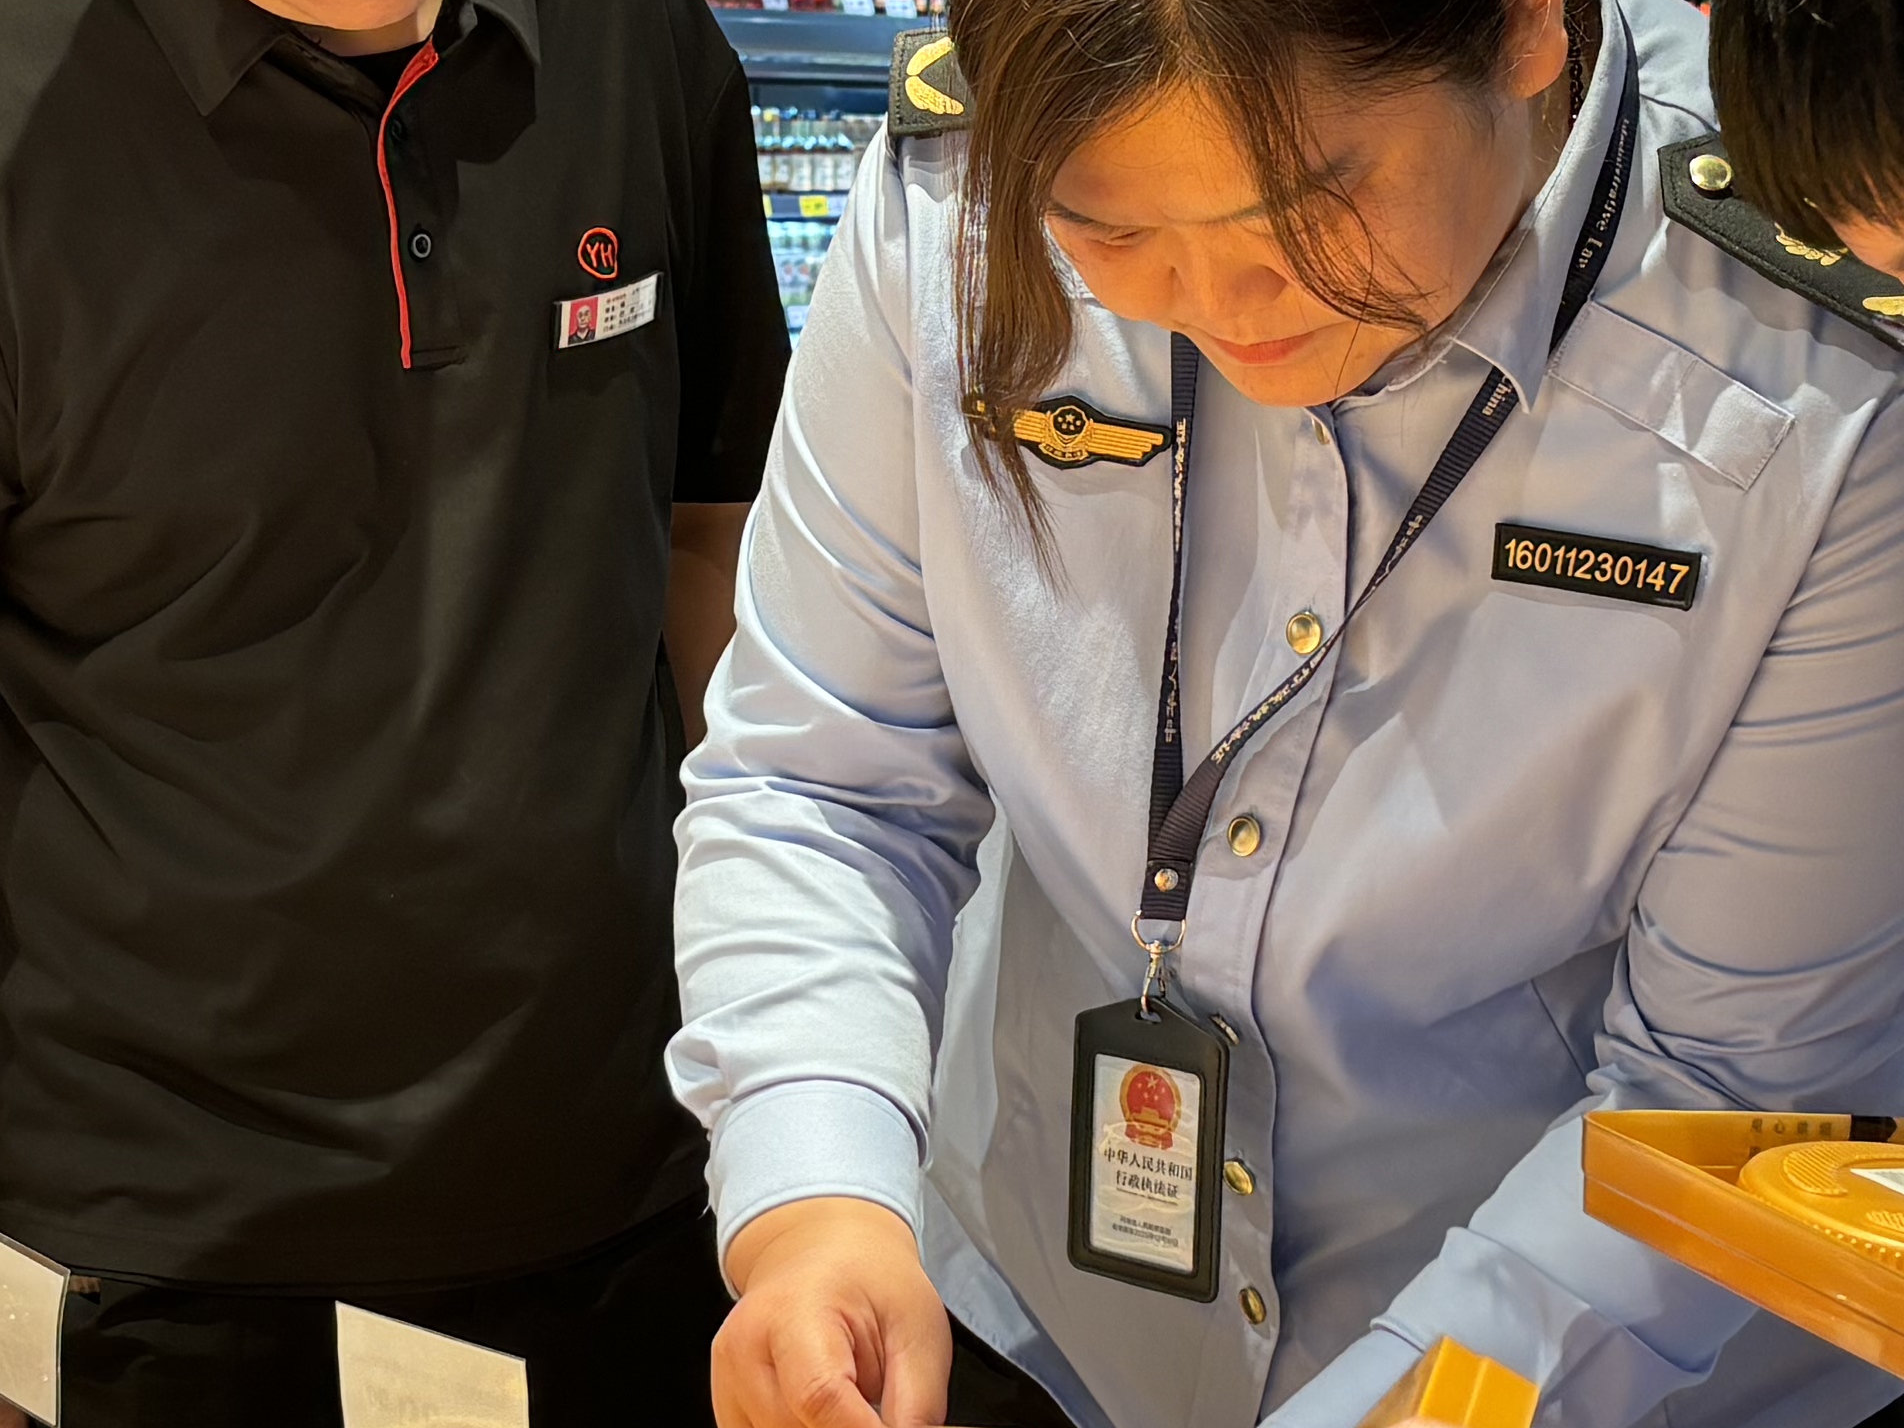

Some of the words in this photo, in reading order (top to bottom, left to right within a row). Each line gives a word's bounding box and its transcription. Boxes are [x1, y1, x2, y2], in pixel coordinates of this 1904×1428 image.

[1504, 537, 1690, 594] 16011230147
[1104, 1147, 1193, 1181] 中华人民共和国
[1116, 1170, 1179, 1199] 行政执法证
